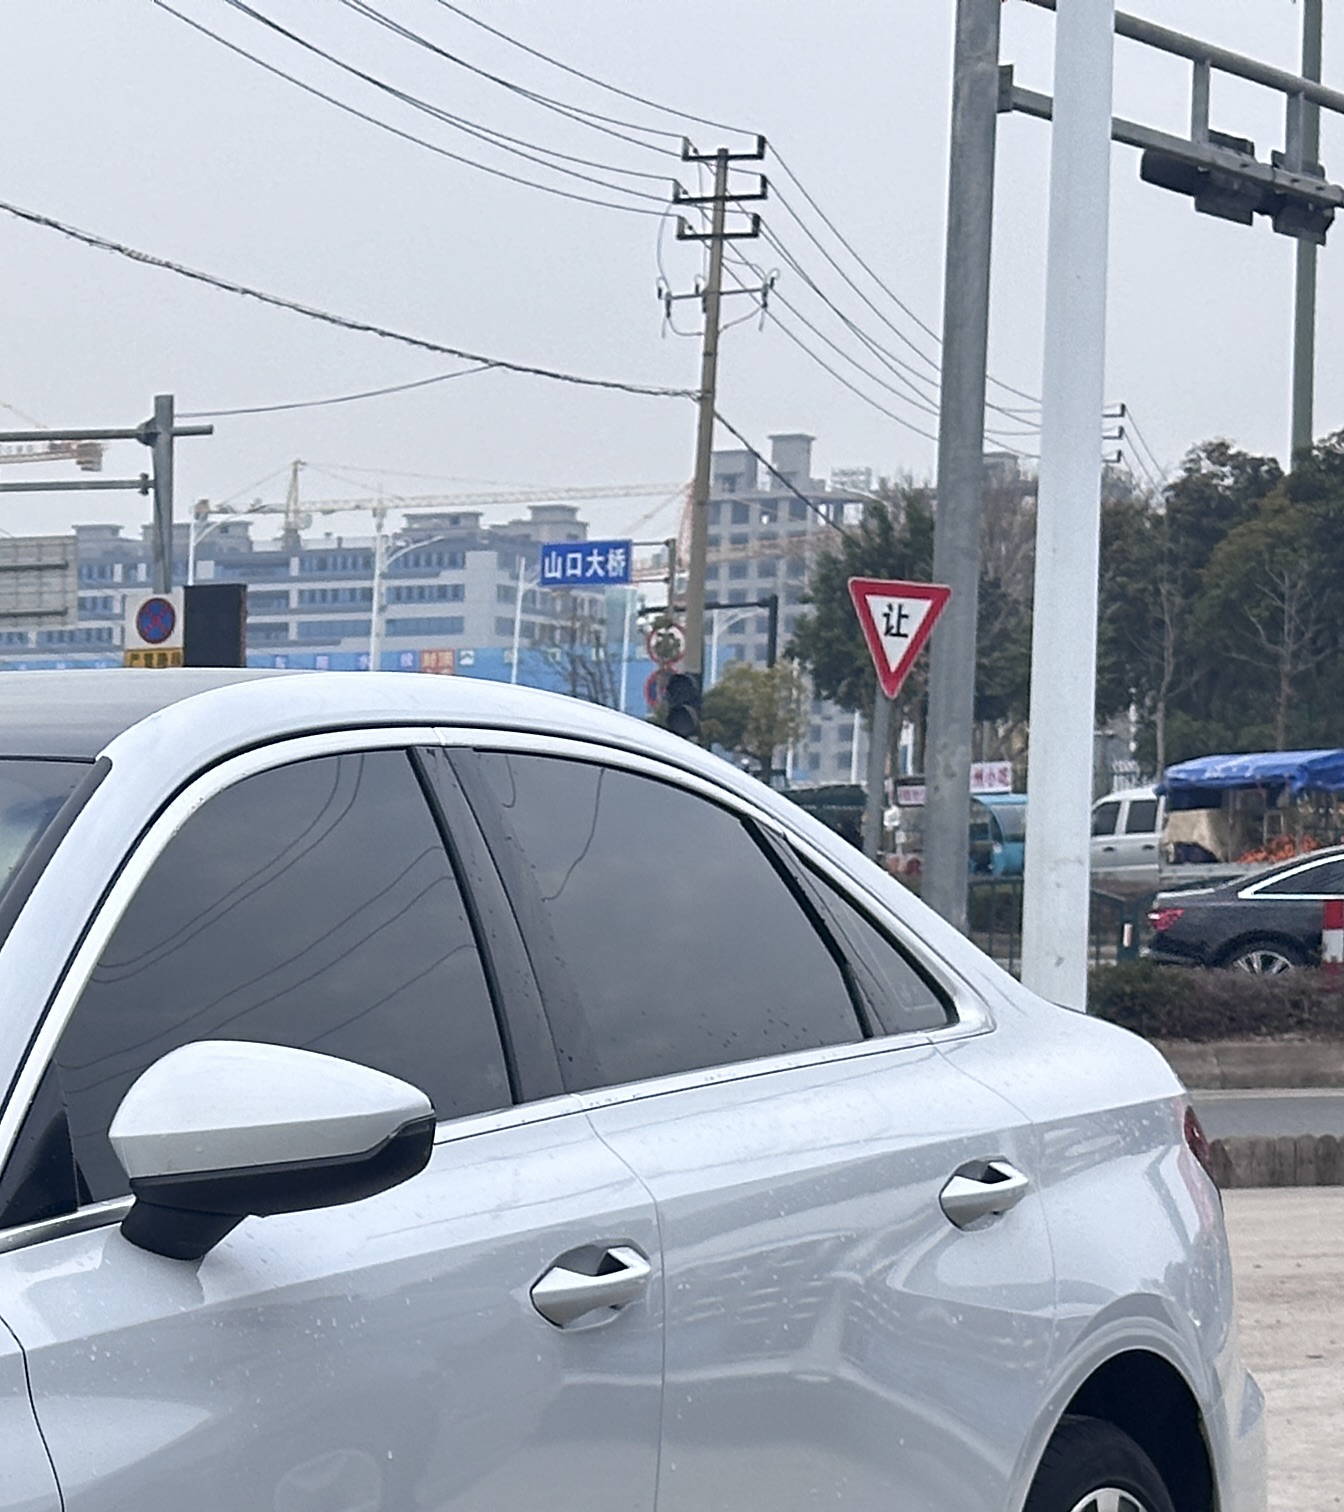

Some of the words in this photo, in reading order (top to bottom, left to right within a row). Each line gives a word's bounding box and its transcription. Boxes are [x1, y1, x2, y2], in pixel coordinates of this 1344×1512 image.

[544, 548, 626, 579] 山口大桥
[882, 603, 910, 638] 让
